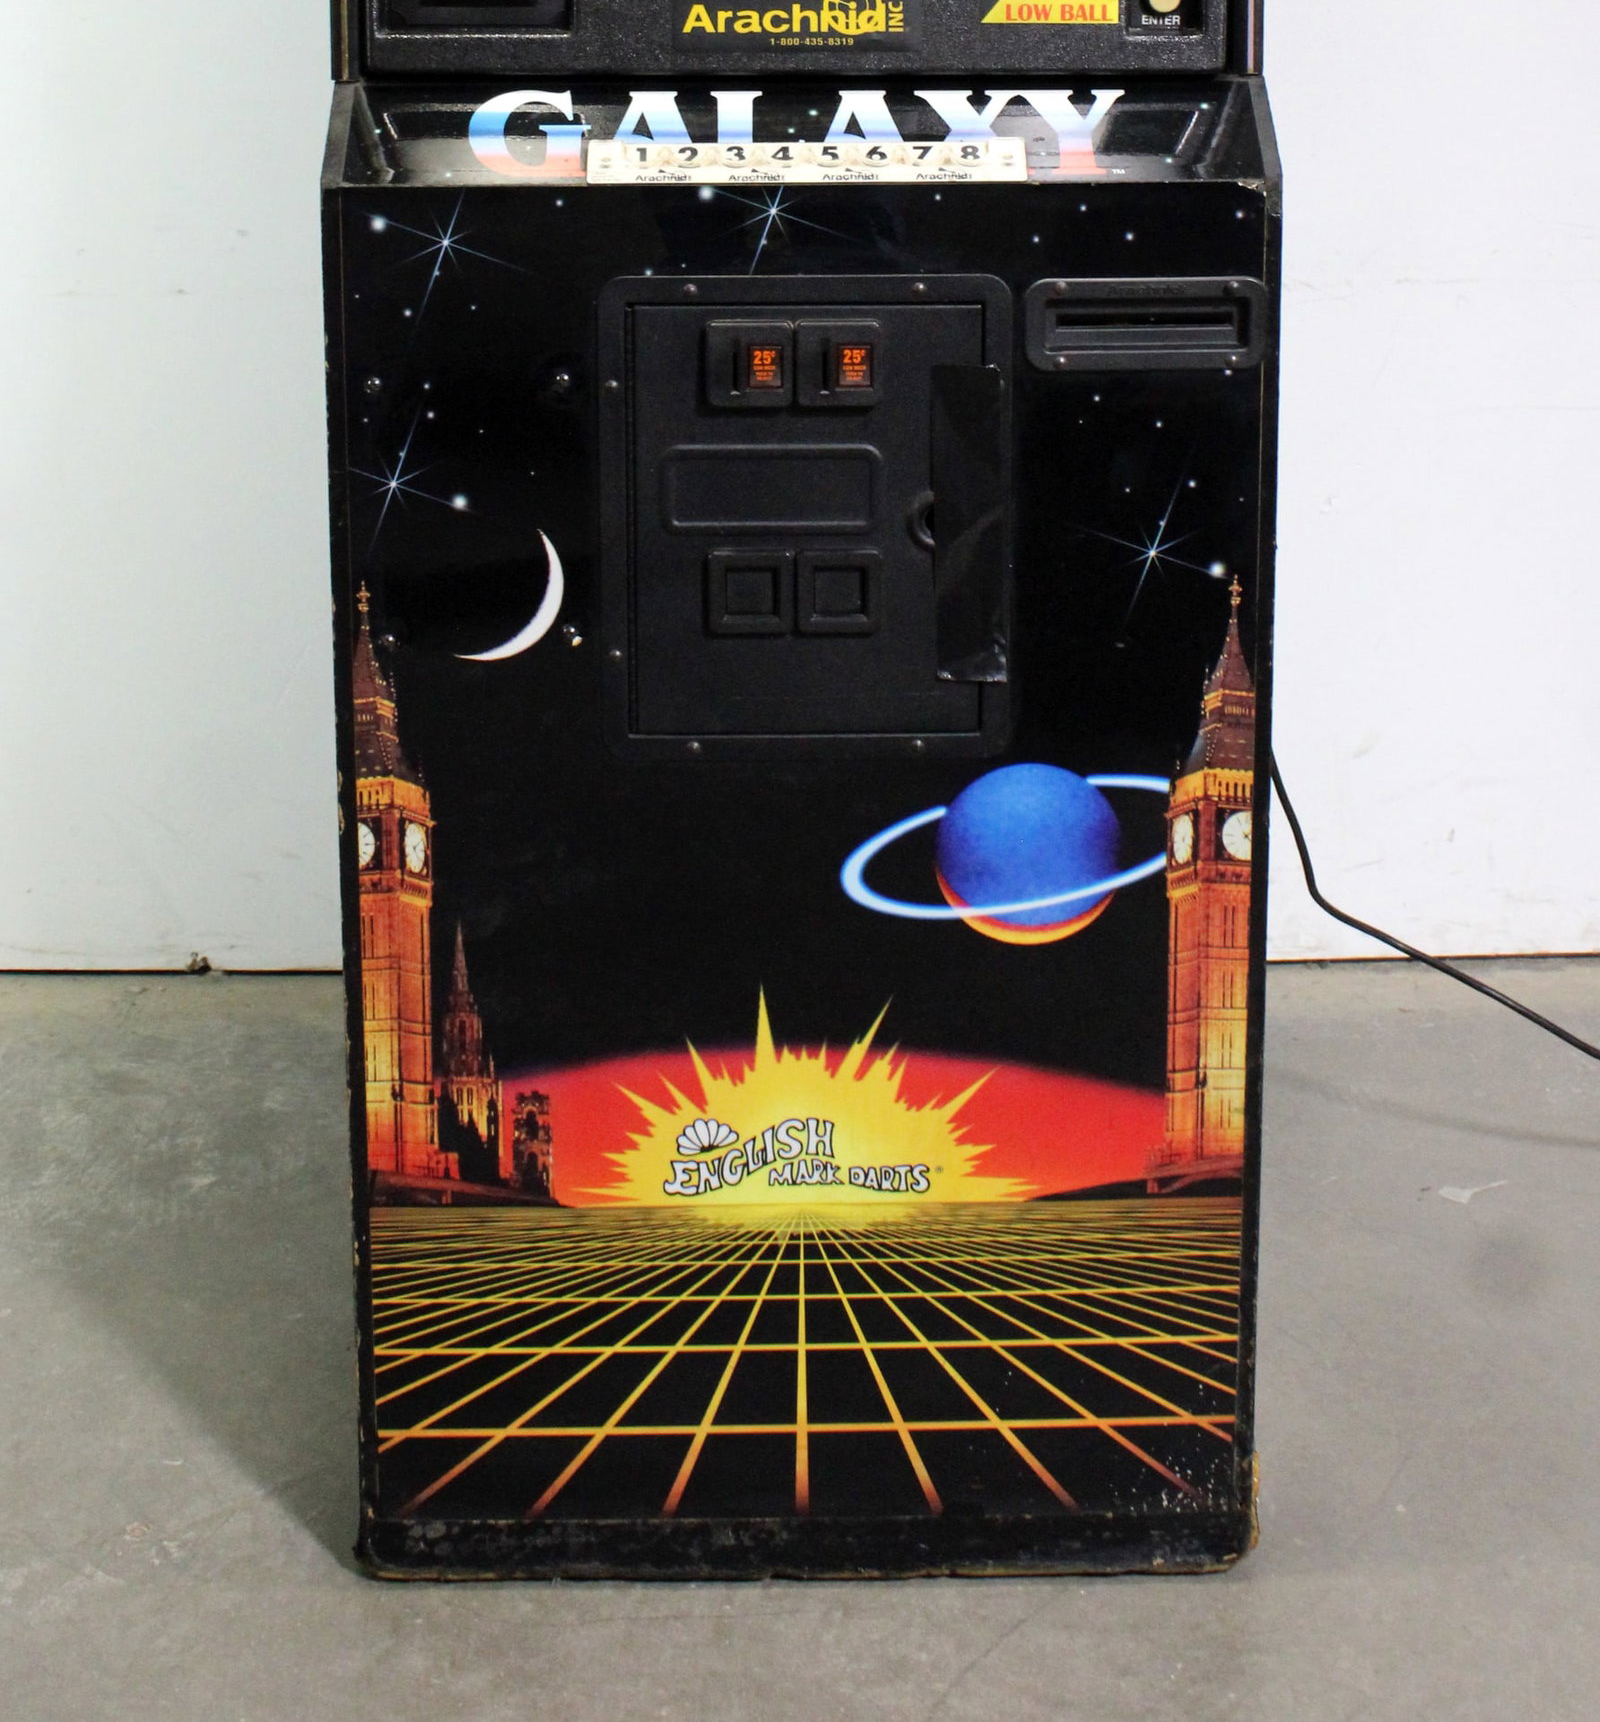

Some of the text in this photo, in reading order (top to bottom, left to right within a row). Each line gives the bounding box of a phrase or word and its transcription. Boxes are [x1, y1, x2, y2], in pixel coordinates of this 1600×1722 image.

[682, 3, 886, 34] Arachnid
[888, 1, 904, 32] INC
[1006, 4, 1113, 21] LOW BALL
[1141, 15, 1181, 26] ENTER
[770, 37, 854, 46] 1-800-435-8319
[636, 145, 980, 162] 1 2 3 4 5 6 7 8
[664, 1117, 835, 1196] ENGLISH
[769, 1158, 930, 1193] MARK DARTS
